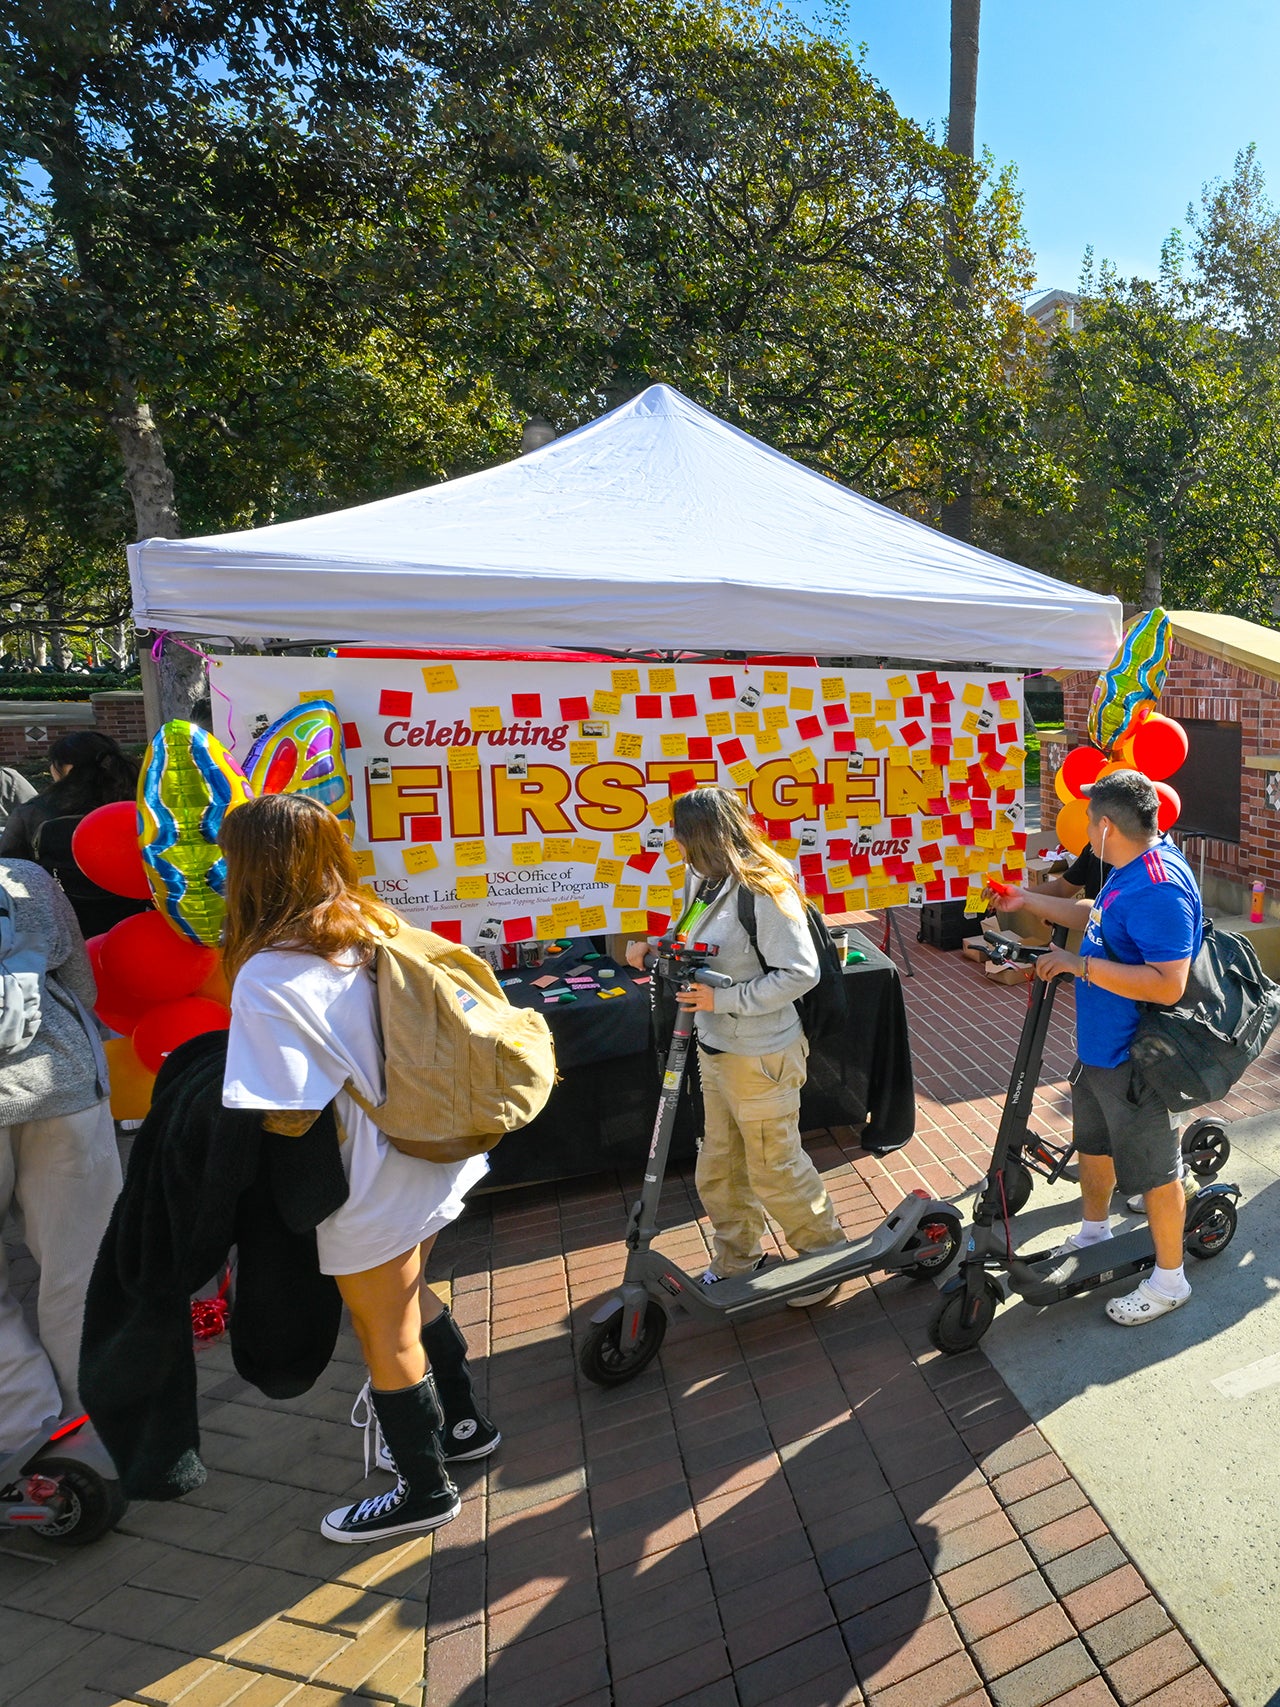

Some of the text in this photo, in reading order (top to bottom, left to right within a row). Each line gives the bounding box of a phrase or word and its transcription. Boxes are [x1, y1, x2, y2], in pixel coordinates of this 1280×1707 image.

[384, 719, 570, 751] Celebrating
[365, 757, 944, 843] FIRSTGEN
[485, 867, 574, 884] USC Office of
[373, 878, 409, 893] USC
[486, 883, 549, 897] Academic
[552, 881, 610, 894] Programs
